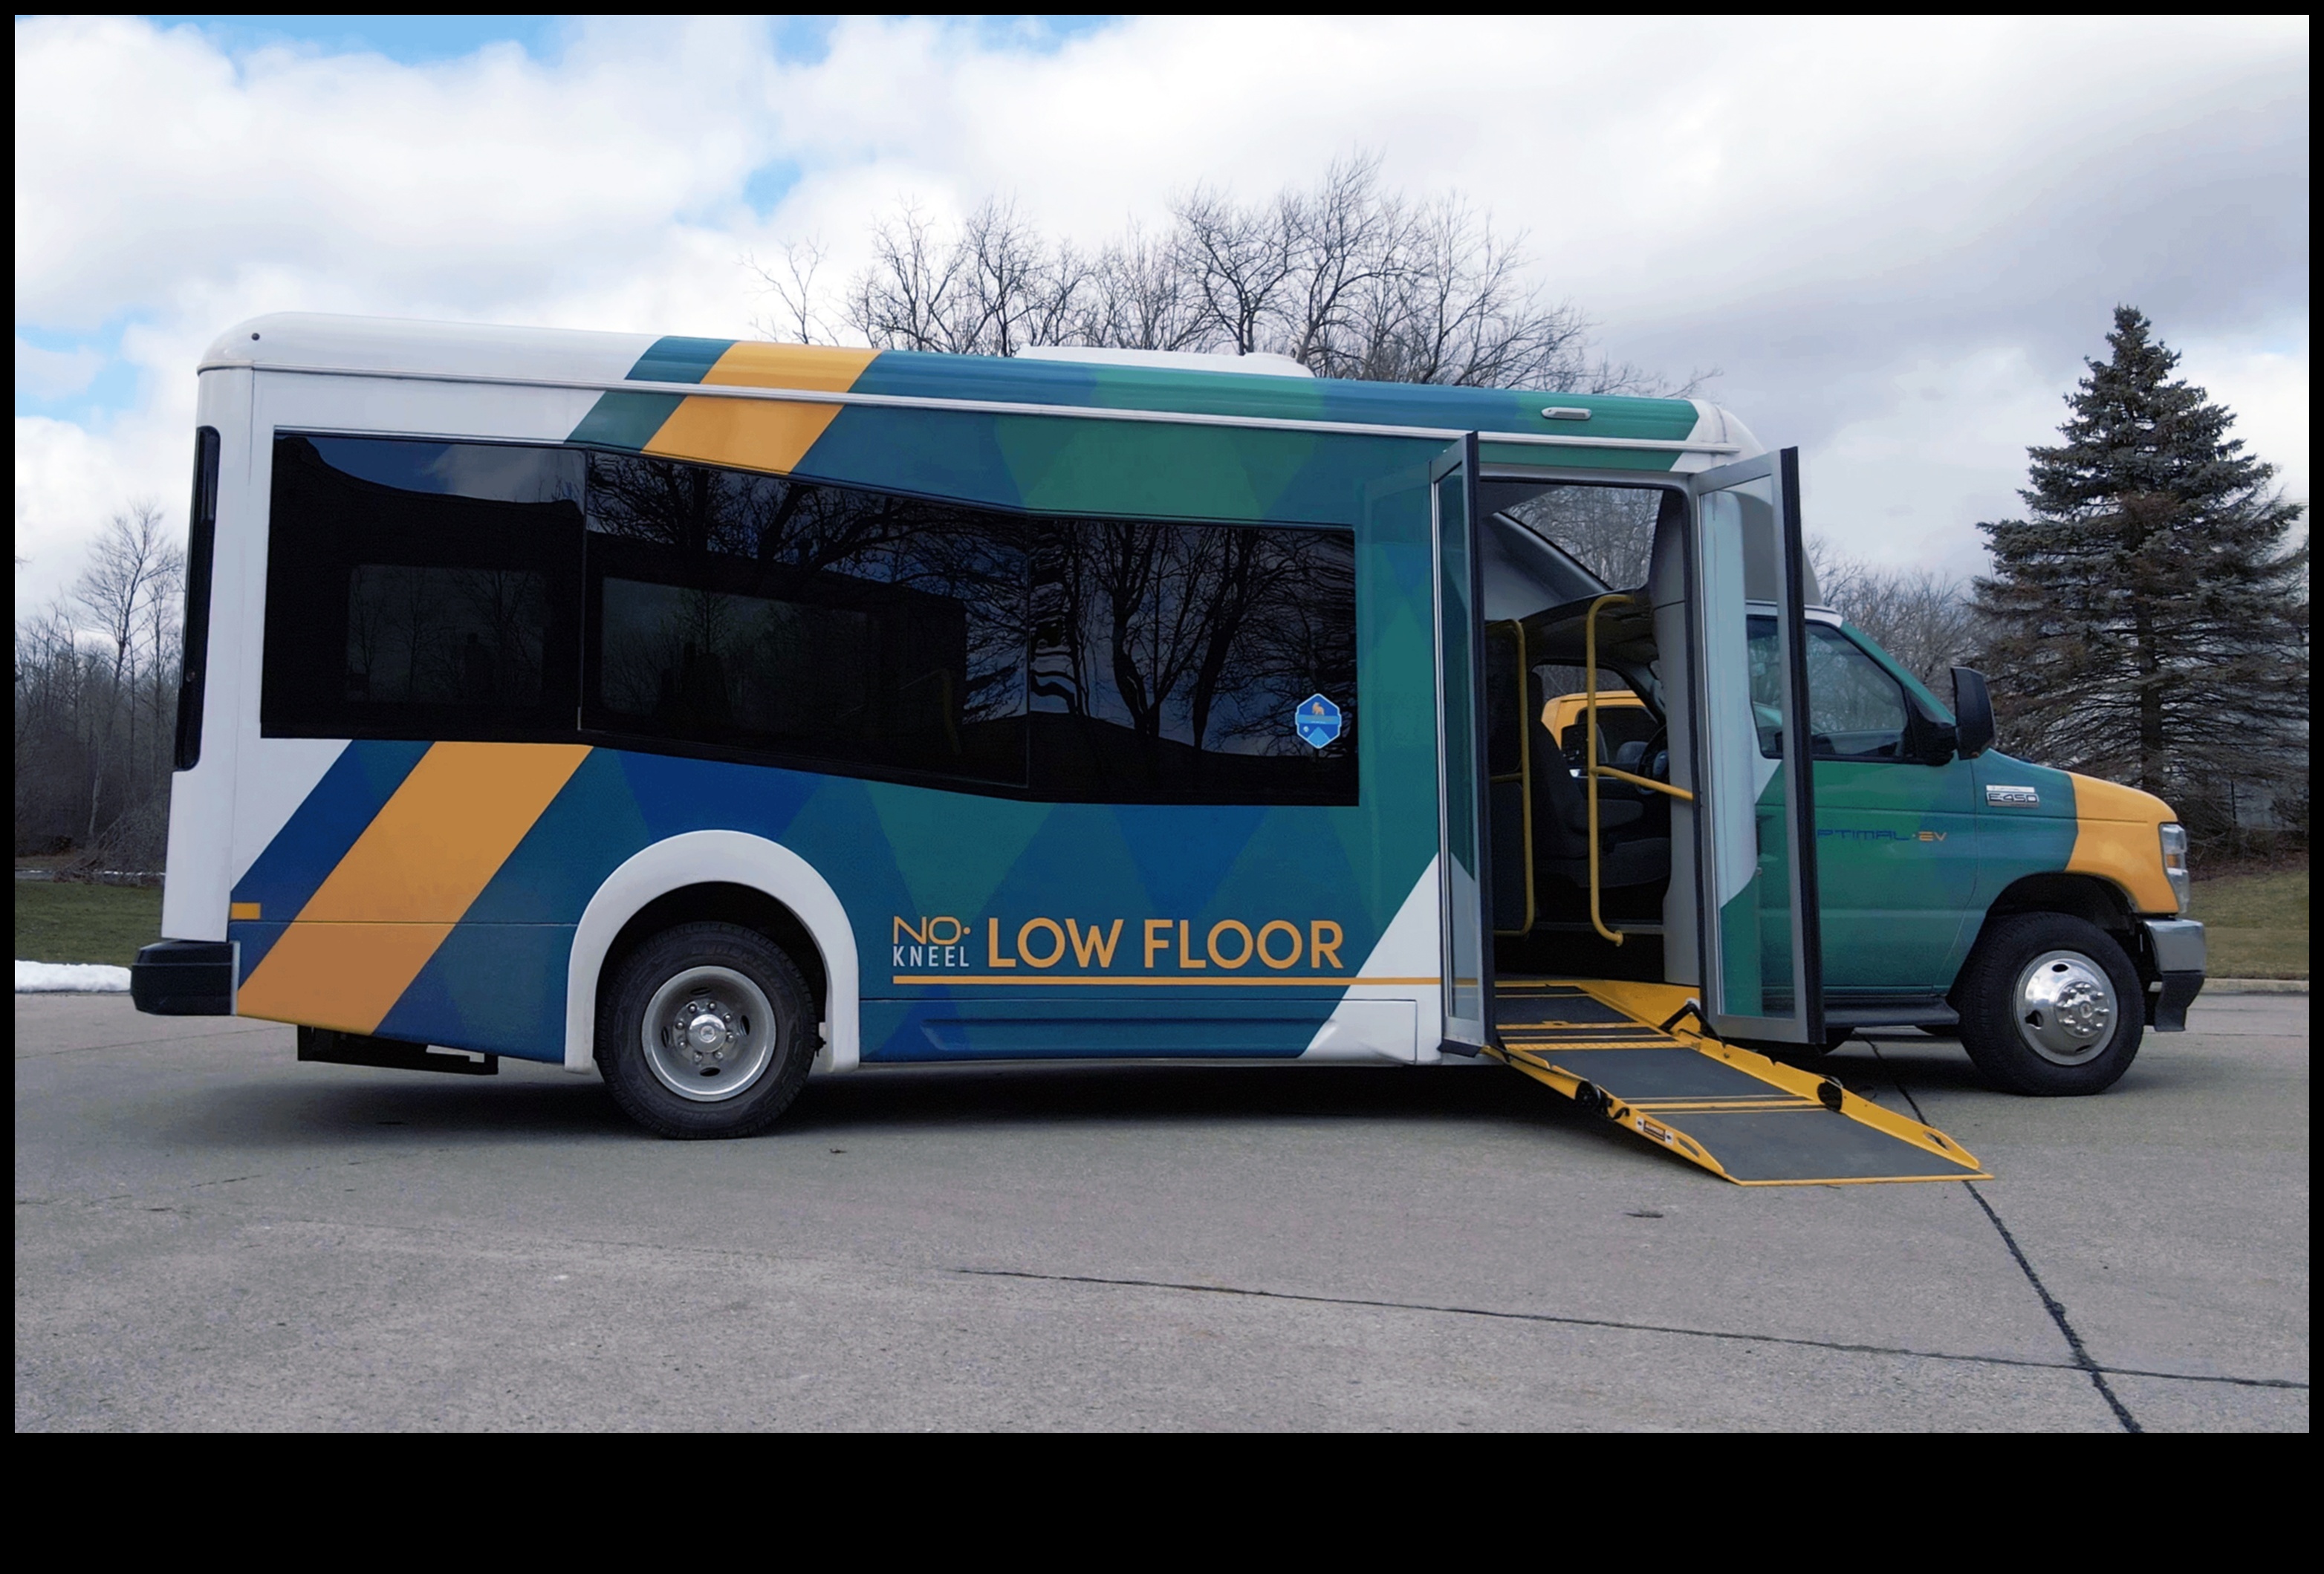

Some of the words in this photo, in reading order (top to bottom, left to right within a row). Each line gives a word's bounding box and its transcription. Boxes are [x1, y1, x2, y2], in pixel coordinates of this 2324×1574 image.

[1988, 793, 2038, 802] E-450
[989, 917, 1124, 969] LOW
[1144, 919, 1344, 969] FLOOR
[893, 946, 970, 967] KNEEL
